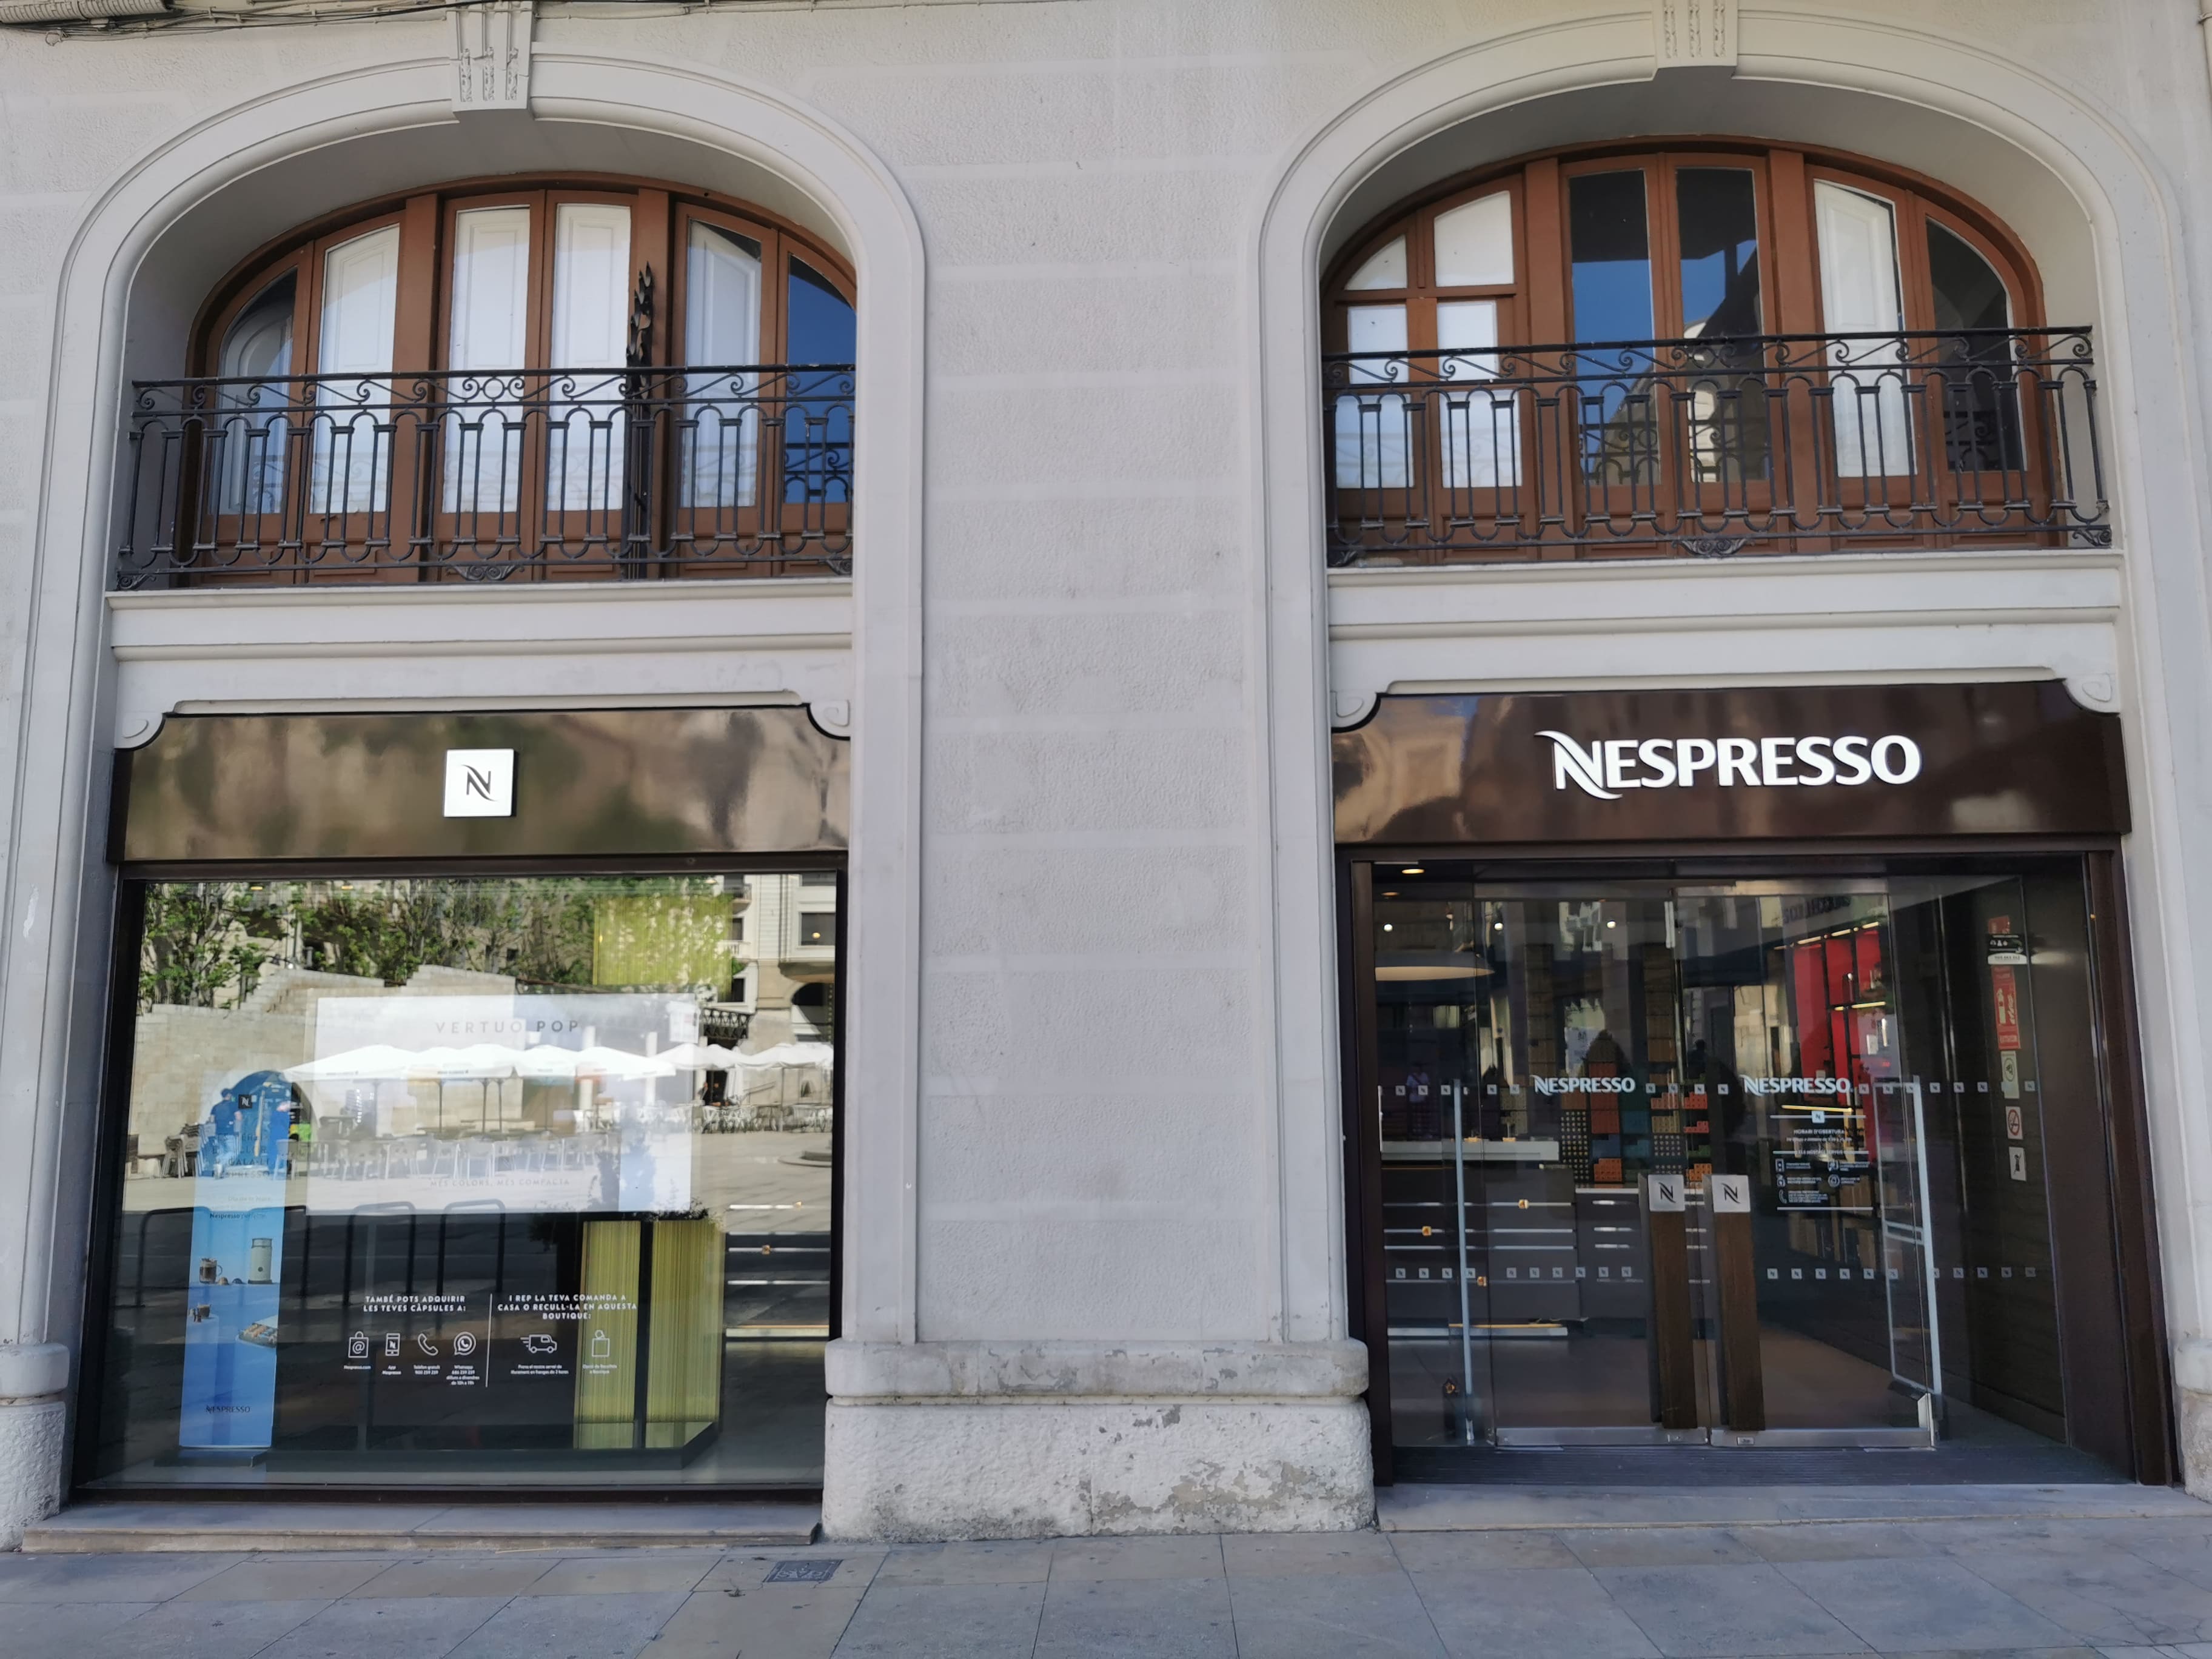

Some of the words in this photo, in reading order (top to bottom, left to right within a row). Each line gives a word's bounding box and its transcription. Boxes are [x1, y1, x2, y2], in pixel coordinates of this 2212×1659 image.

[1533, 730, 1922, 800] NESPRESSO
[436, 1021, 523, 1034] VERTUO
[537, 1020, 578, 1033] POP
[1529, 1074, 1636, 1096] NESPRESSO
[1739, 1074, 1851, 1097] NESPRESSO
[366, 1294, 394, 1303] TAMBÉ
[573, 1294, 617, 1302] COMANDA
[410, 1303, 454, 1312] CÀPSULES
[457, 1304, 466, 1312] A:
[542, 1312, 592, 1321] BOUTIQUE:
[205, 1404, 251, 1413] NESPRESSO
